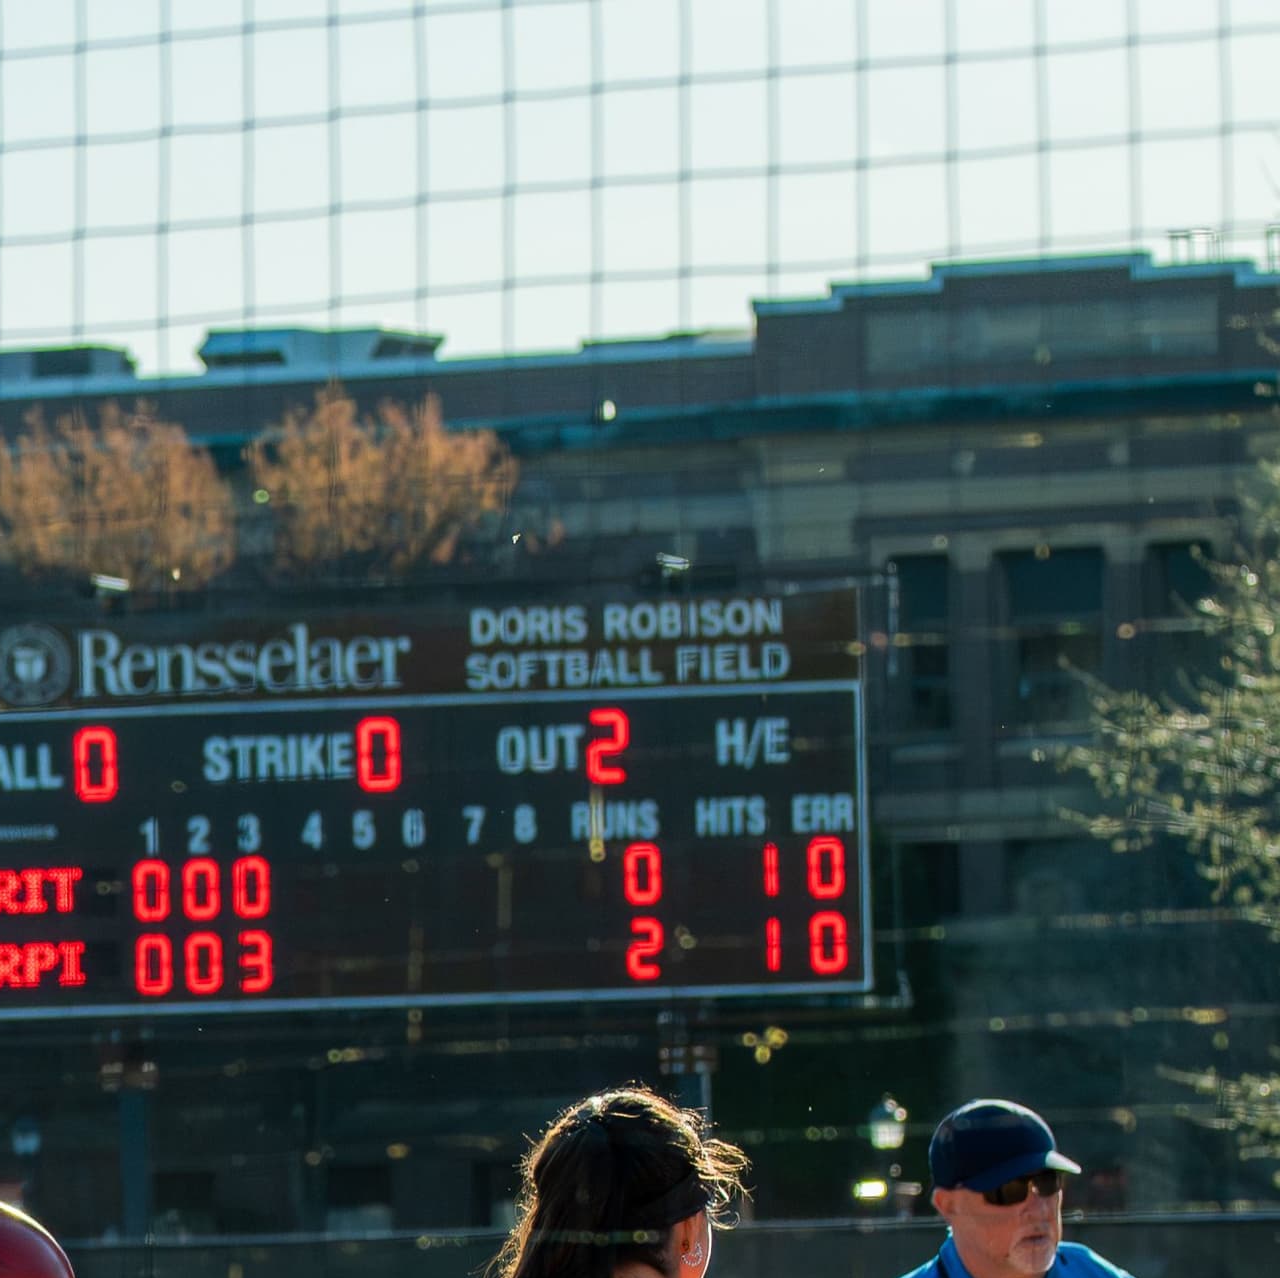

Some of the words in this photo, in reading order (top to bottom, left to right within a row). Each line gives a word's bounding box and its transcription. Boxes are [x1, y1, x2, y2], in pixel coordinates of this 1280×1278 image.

[469, 605, 589, 646] DORIS
[603, 598, 783, 641] ROBISON
[77, 622, 411, 698] Rensselaer
[465, 648, 663, 690] SOFTBALL
[675, 642, 790, 682] FIELD
[72, 725, 119, 803] 0
[203, 732, 354, 782] STRIKE
[355, 715, 402, 793] 0
[496, 724, 586, 774] OUT
[585, 707, 630, 785] 2
[715, 717, 791, 768] H/E
[140, 818, 159, 855] 1
[187, 816, 210, 854] 2
[238, 814, 261, 853] 3
[302, 812, 324, 849] 4
[352, 810, 375, 849] 5
[402, 809, 425, 847] 6
[463, 806, 486, 844] 7
[514, 804, 537, 843] 8
[571, 799, 659, 842] RUNS
[695, 796, 767, 837] HITS
[791, 793, 853, 833] ERR
[623, 841, 663, 907] 0
[625, 916, 665, 981] 2
